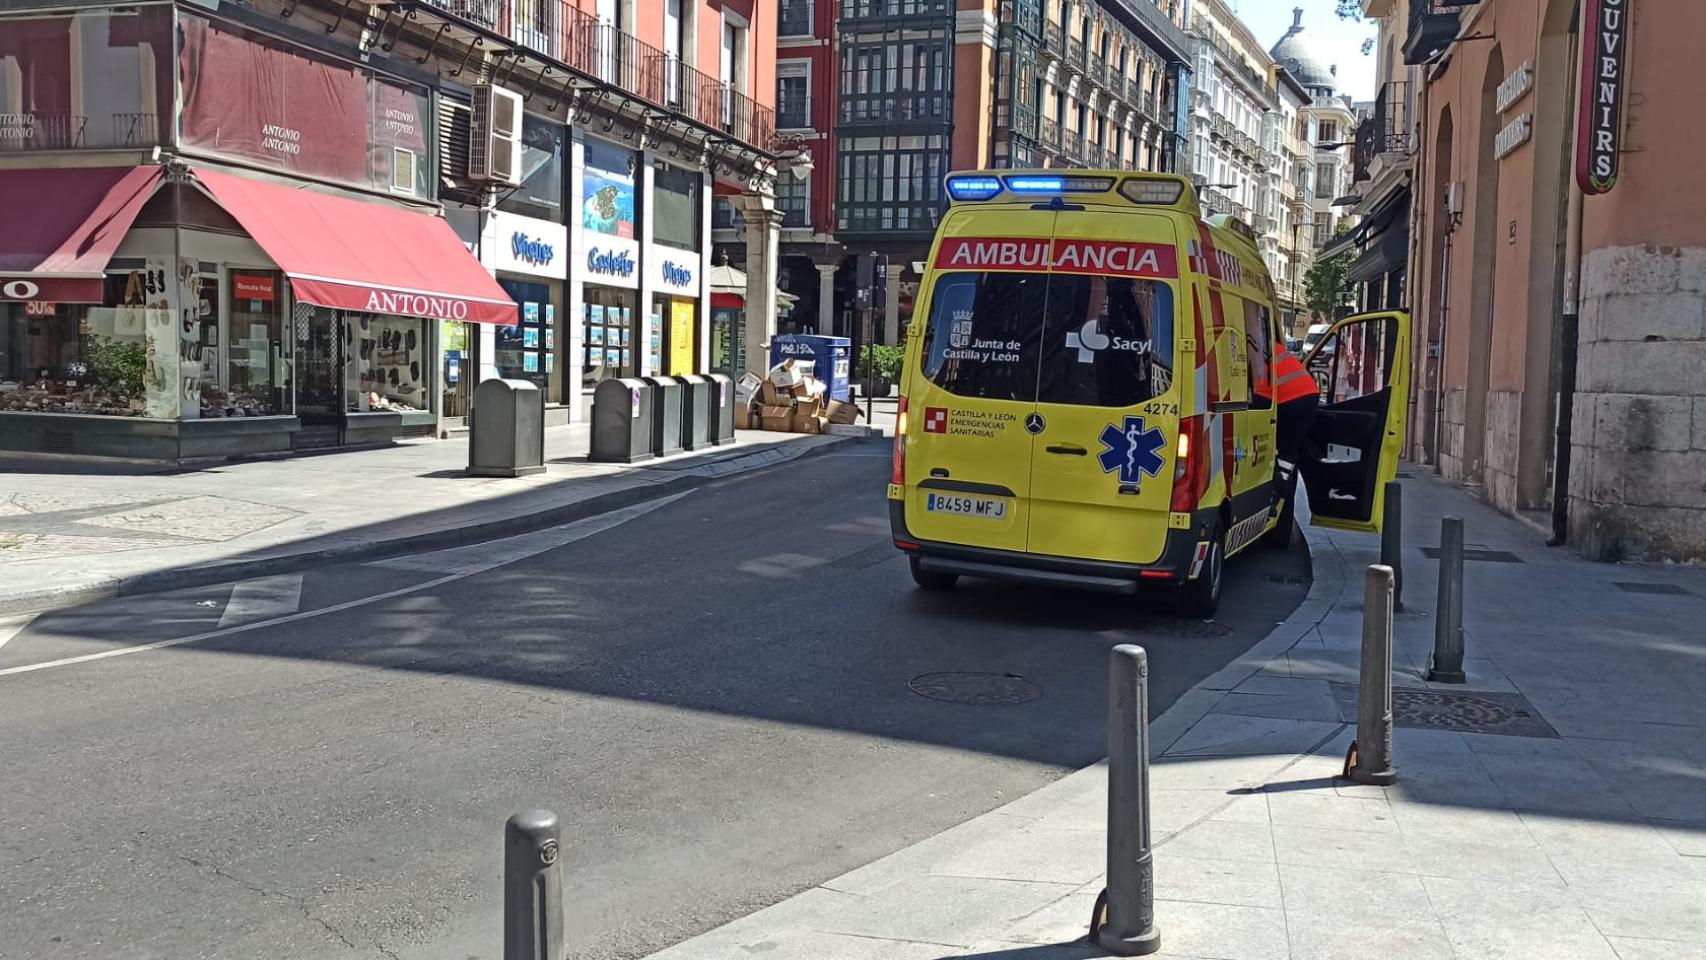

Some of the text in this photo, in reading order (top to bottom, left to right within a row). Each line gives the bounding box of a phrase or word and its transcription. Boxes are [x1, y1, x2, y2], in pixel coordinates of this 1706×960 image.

[1595, 0, 1622, 176] UVENIRS
[385, 108, 414, 123] ANTONIO
[262, 124, 300, 141] ANTONIO
[385, 120, 414, 135] ANTONIO
[261, 137, 300, 155] ANTONIO
[512, 231, 553, 264] Viajes
[951, 242, 1160, 273] AMBULANCIA
[662, 260, 691, 286] Viajes
[365, 290, 467, 320] ANTONIO
[972, 338, 1021, 350] Junta de
[1112, 336, 1152, 355] Sacyl
[942, 348, 1020, 363] Castilla y León
[951, 409, 985, 419] CASTILLA
[1143, 402, 1179, 416] 4274
[950, 418, 1005, 430] EMERGENCIAS
[950, 427, 994, 438] SANITARIAS
[936, 496, 1004, 517] 8459 MFJ
